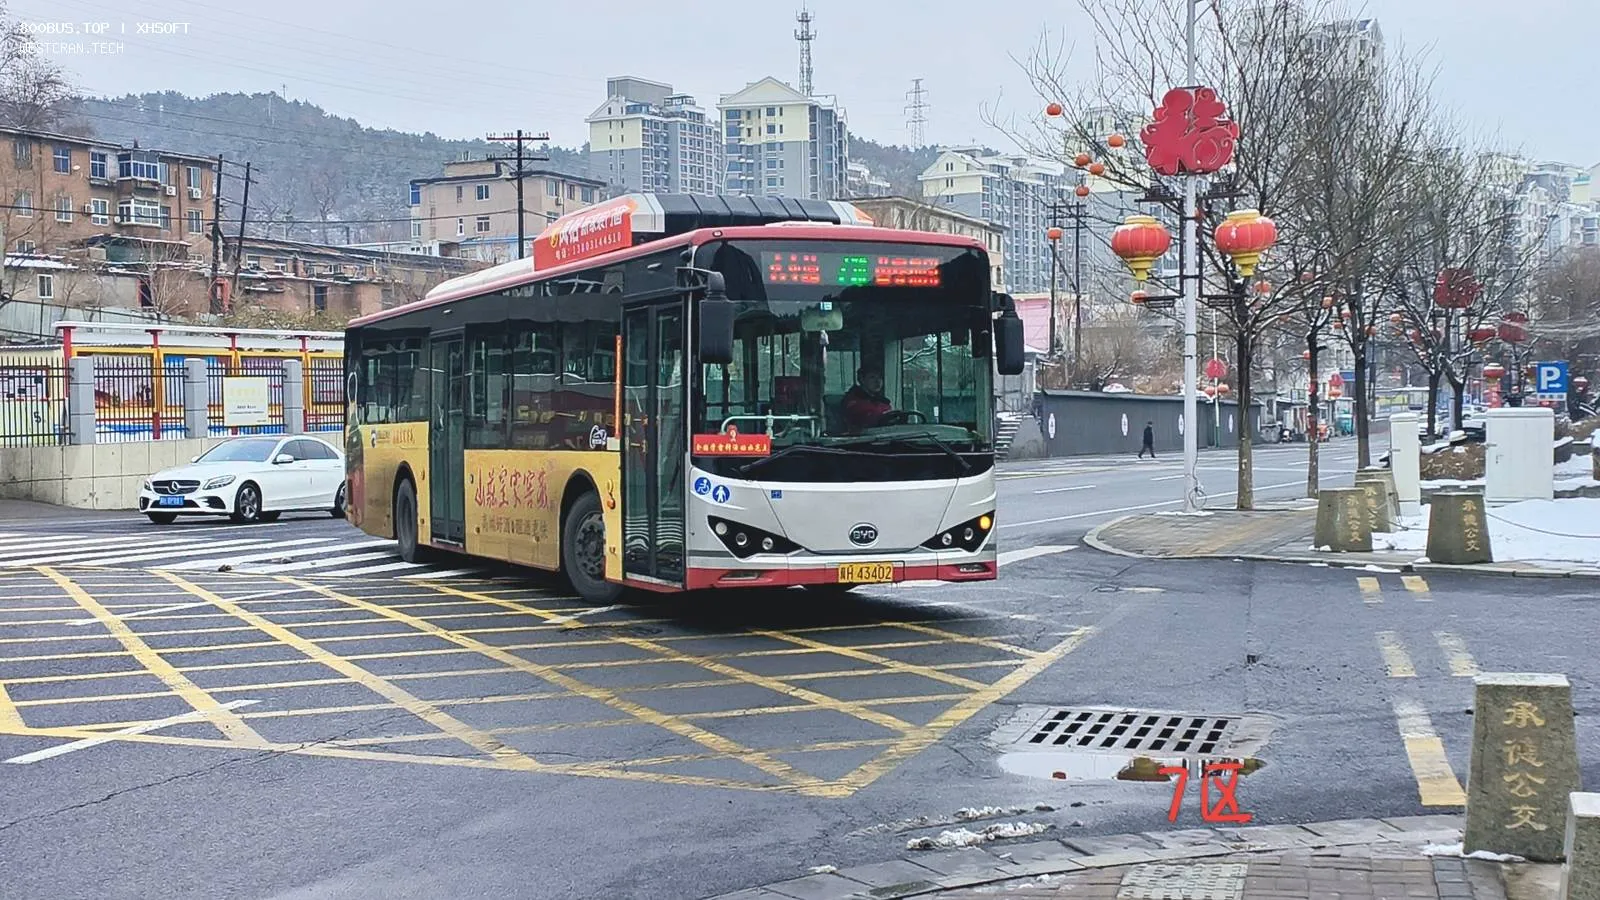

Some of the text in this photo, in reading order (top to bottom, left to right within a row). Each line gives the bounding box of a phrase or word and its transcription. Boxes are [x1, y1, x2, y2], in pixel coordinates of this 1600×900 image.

[1540, 366, 1561, 390] P
[853, 530, 876, 539] BYD
[1502, 701, 1548, 831] 承德公交
